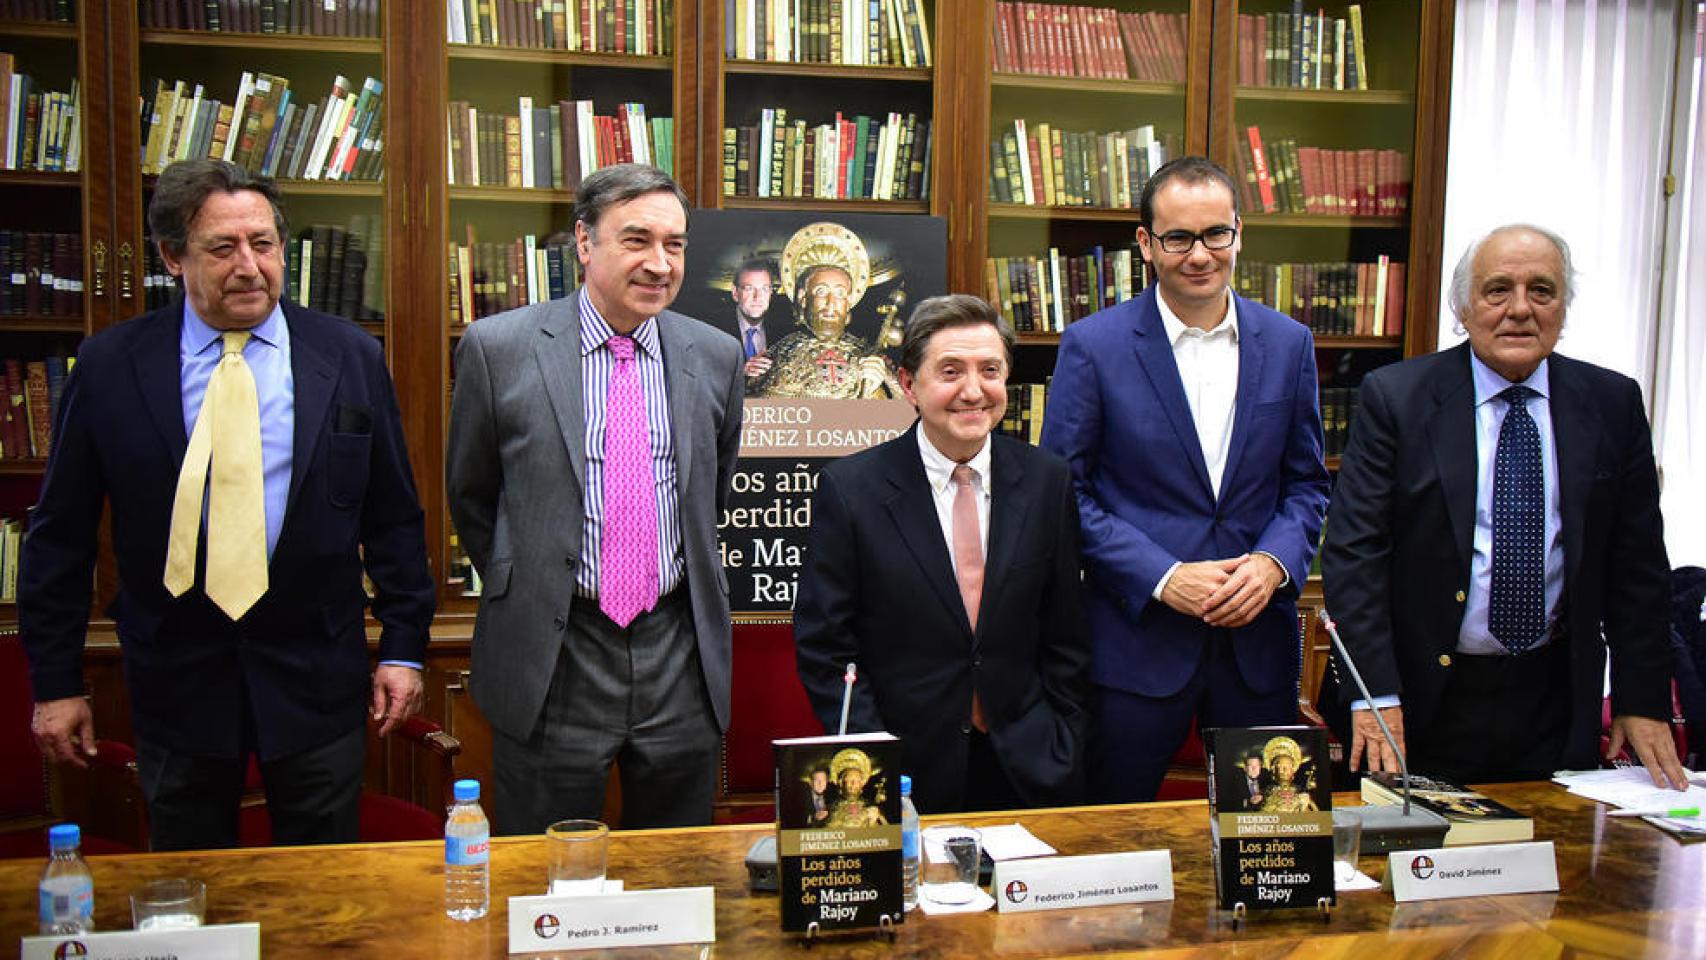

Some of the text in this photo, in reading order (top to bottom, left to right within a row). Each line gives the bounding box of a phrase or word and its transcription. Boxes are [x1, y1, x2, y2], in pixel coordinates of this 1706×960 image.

[806, 429, 906, 447] LOSANTO
[752, 538, 807, 567] Ma
[751, 572, 799, 610] Raj
[800, 831, 846, 841] FEDERICO
[1277, 824, 1321, 833] LOSANTOS
[843, 838, 889, 849] LOSANTOS
[1239, 838, 1295, 853] Los años
[801, 855, 862, 871] Los años
[1239, 854, 1296, 872] perdidos
[801, 871, 862, 891] perdidos
[1239, 870, 1310, 885] de Mariano
[1438, 869, 1464, 880] David
[801, 887, 878, 904] de Mariano
[1034, 891, 1075, 903] Federico
[1117, 883, 1159, 895] Losantos
[1257, 885, 1293, 902] Rajoy
[820, 904, 858, 921] Rajoy
[566, 928, 600, 939] Pedro
[602, 927, 612, 936] J.
